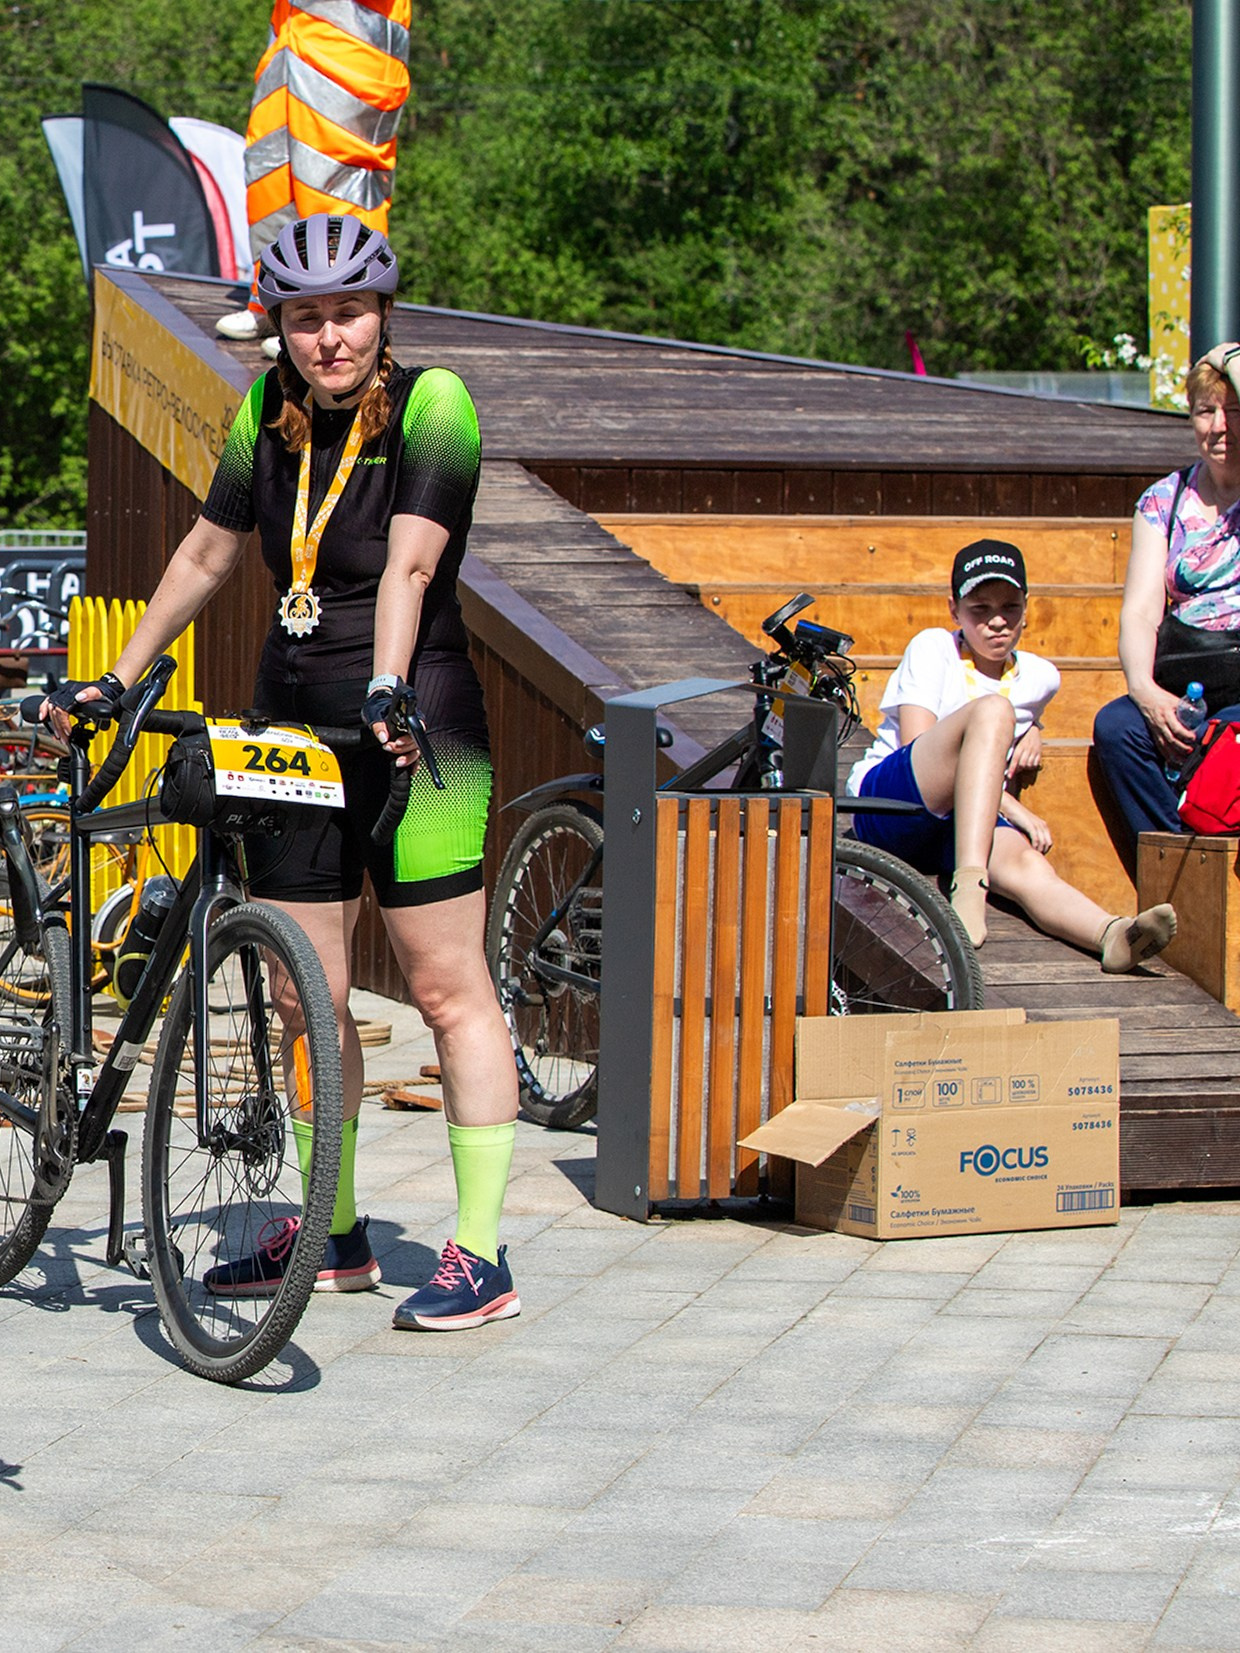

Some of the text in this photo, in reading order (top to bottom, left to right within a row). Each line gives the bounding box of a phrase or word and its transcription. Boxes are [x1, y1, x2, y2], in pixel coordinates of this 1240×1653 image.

[963, 554, 1016, 572] OFF ROAD
[242, 744, 312, 777] 264
[894, 1060, 926, 1068] Салфетки
[937, 1081, 958, 1096] 100
[1012, 1079, 1026, 1089] 100
[1067, 1084, 1113, 1096] 5078436
[897, 1088, 903, 1104] 1
[1072, 1119, 1112, 1131] 5078436
[960, 1144, 1049, 1177] FOCUS
[995, 1174, 1048, 1184] ECONOMIC CHOICE
[901, 1190, 920, 1199] 100%
[890, 1206, 975, 1219] Салфетки Бумажные
